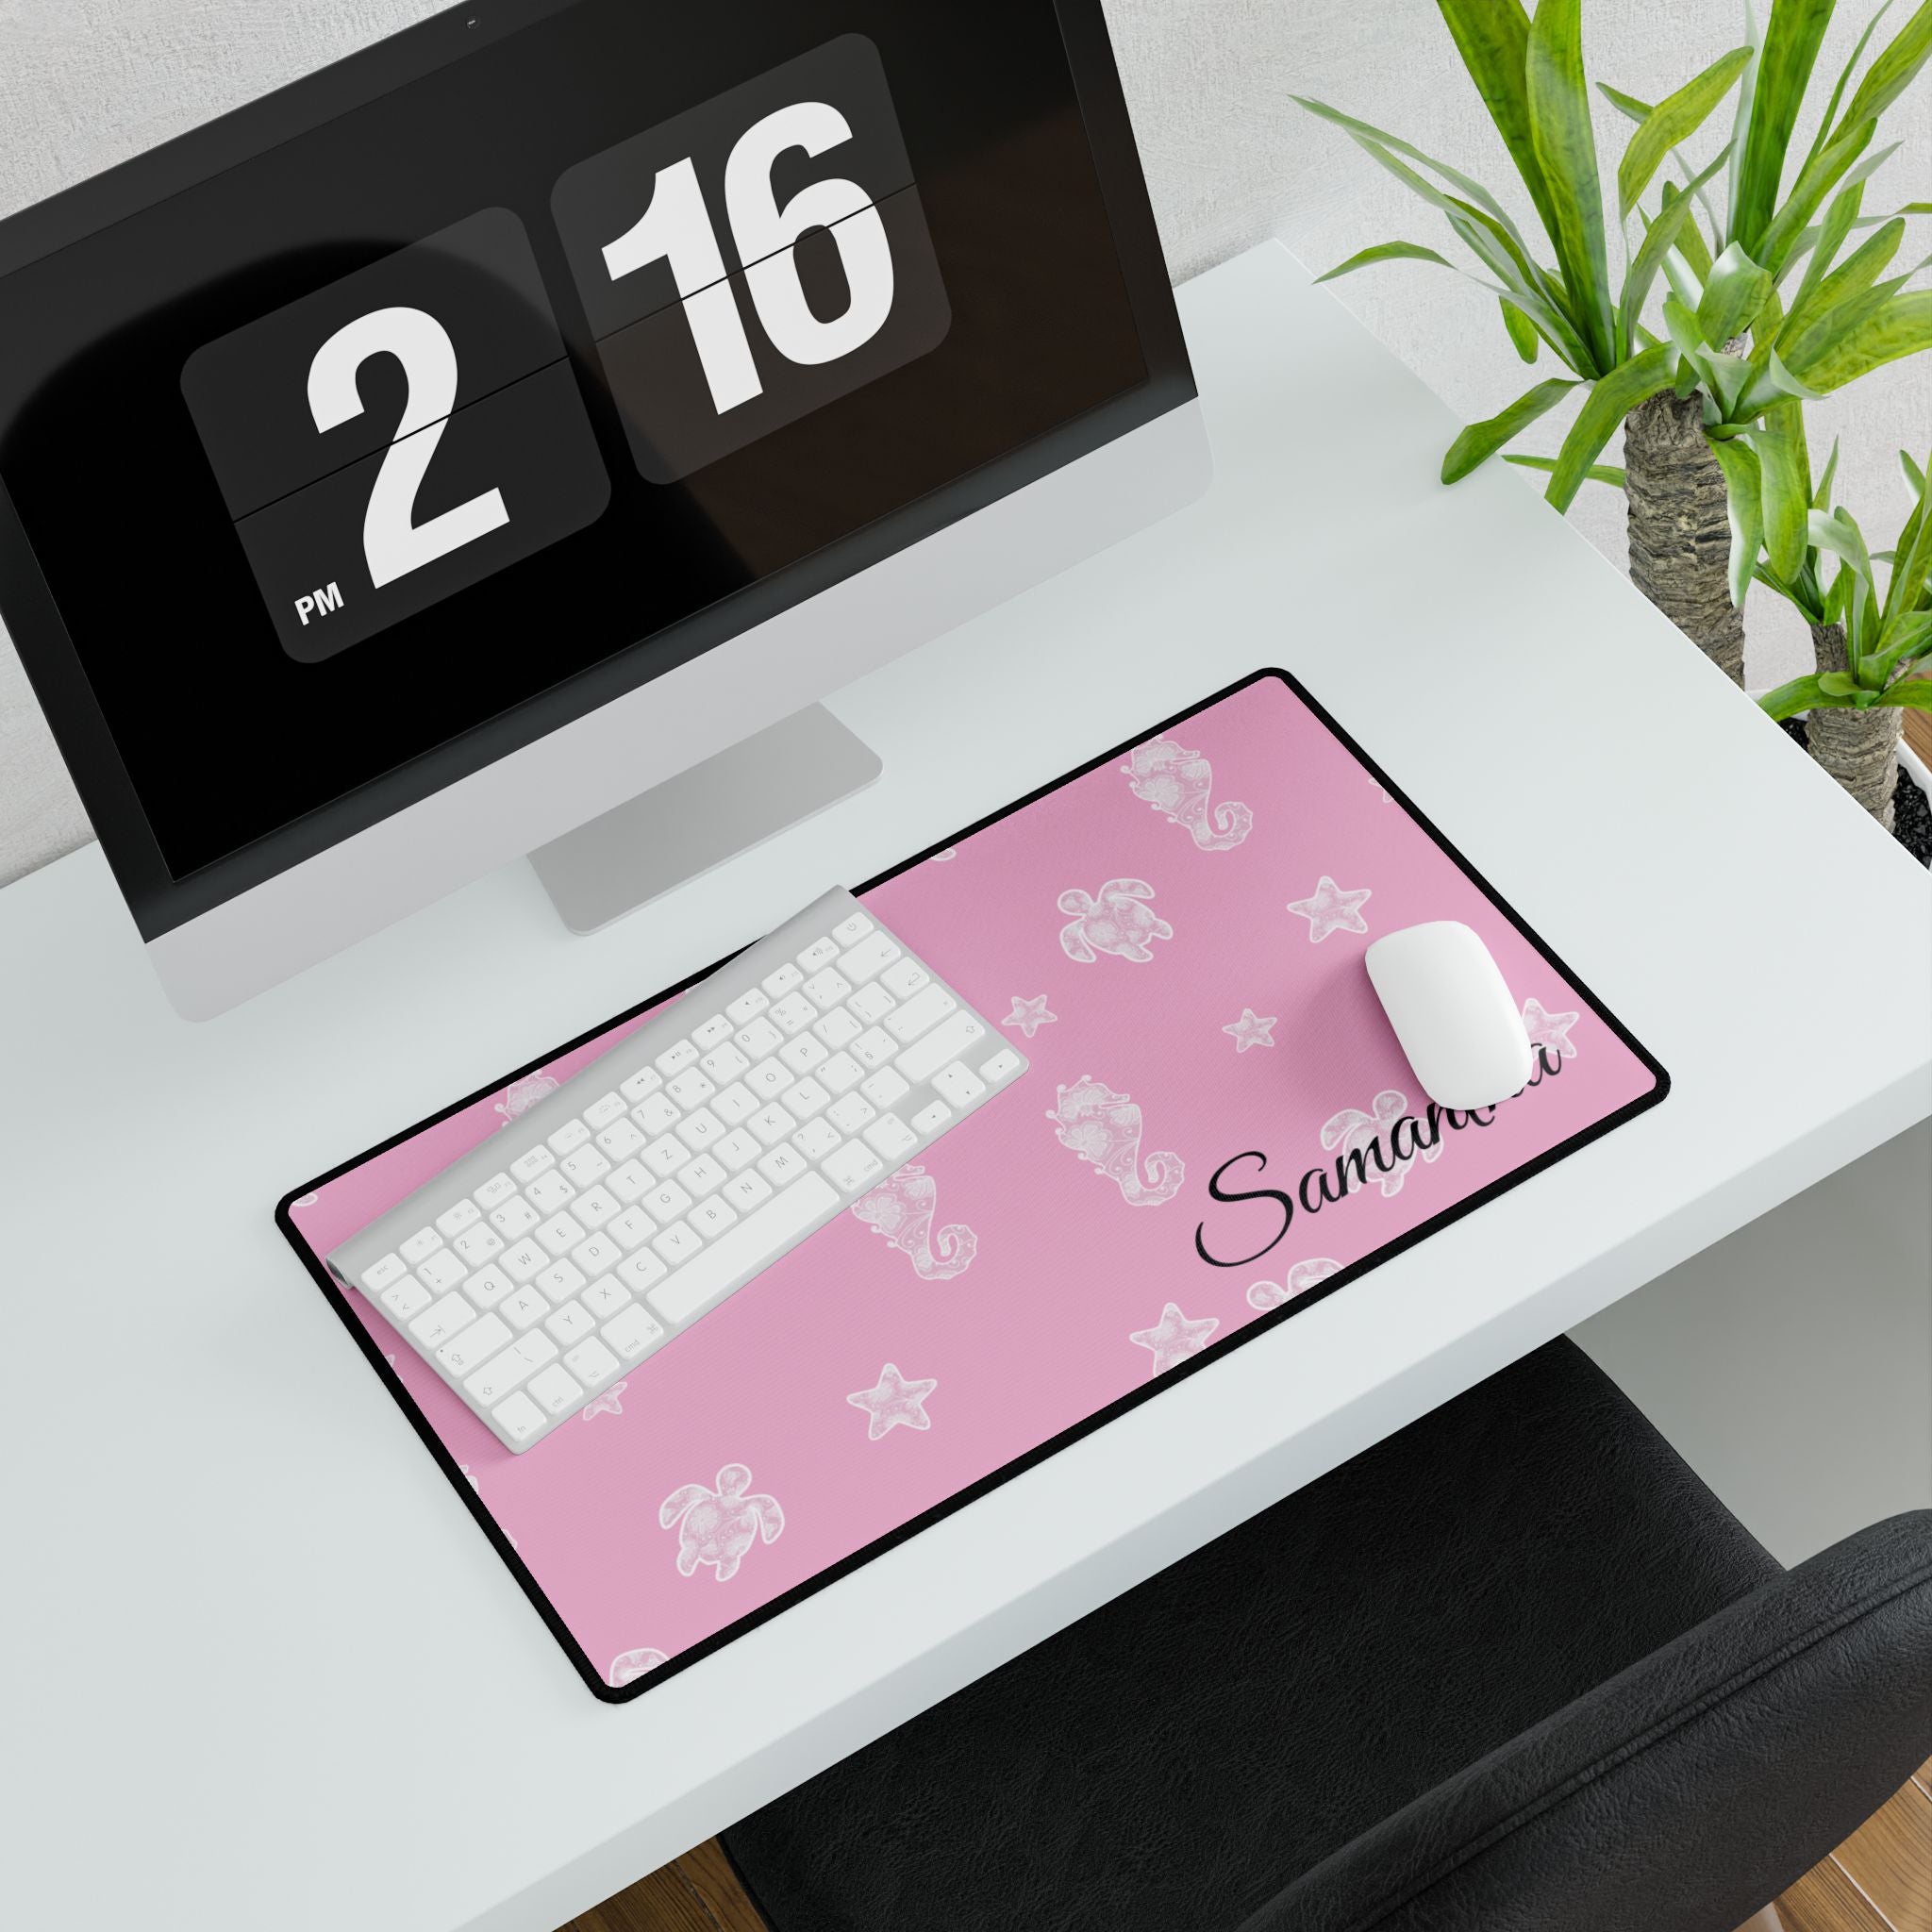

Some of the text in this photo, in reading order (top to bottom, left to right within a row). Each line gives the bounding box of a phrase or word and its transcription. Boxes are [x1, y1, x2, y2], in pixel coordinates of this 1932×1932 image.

[308, 101, 894, 590] 2 16
[294, 581, 344, 625] PM
[1195, 1041, 1562, 1267] Samana
